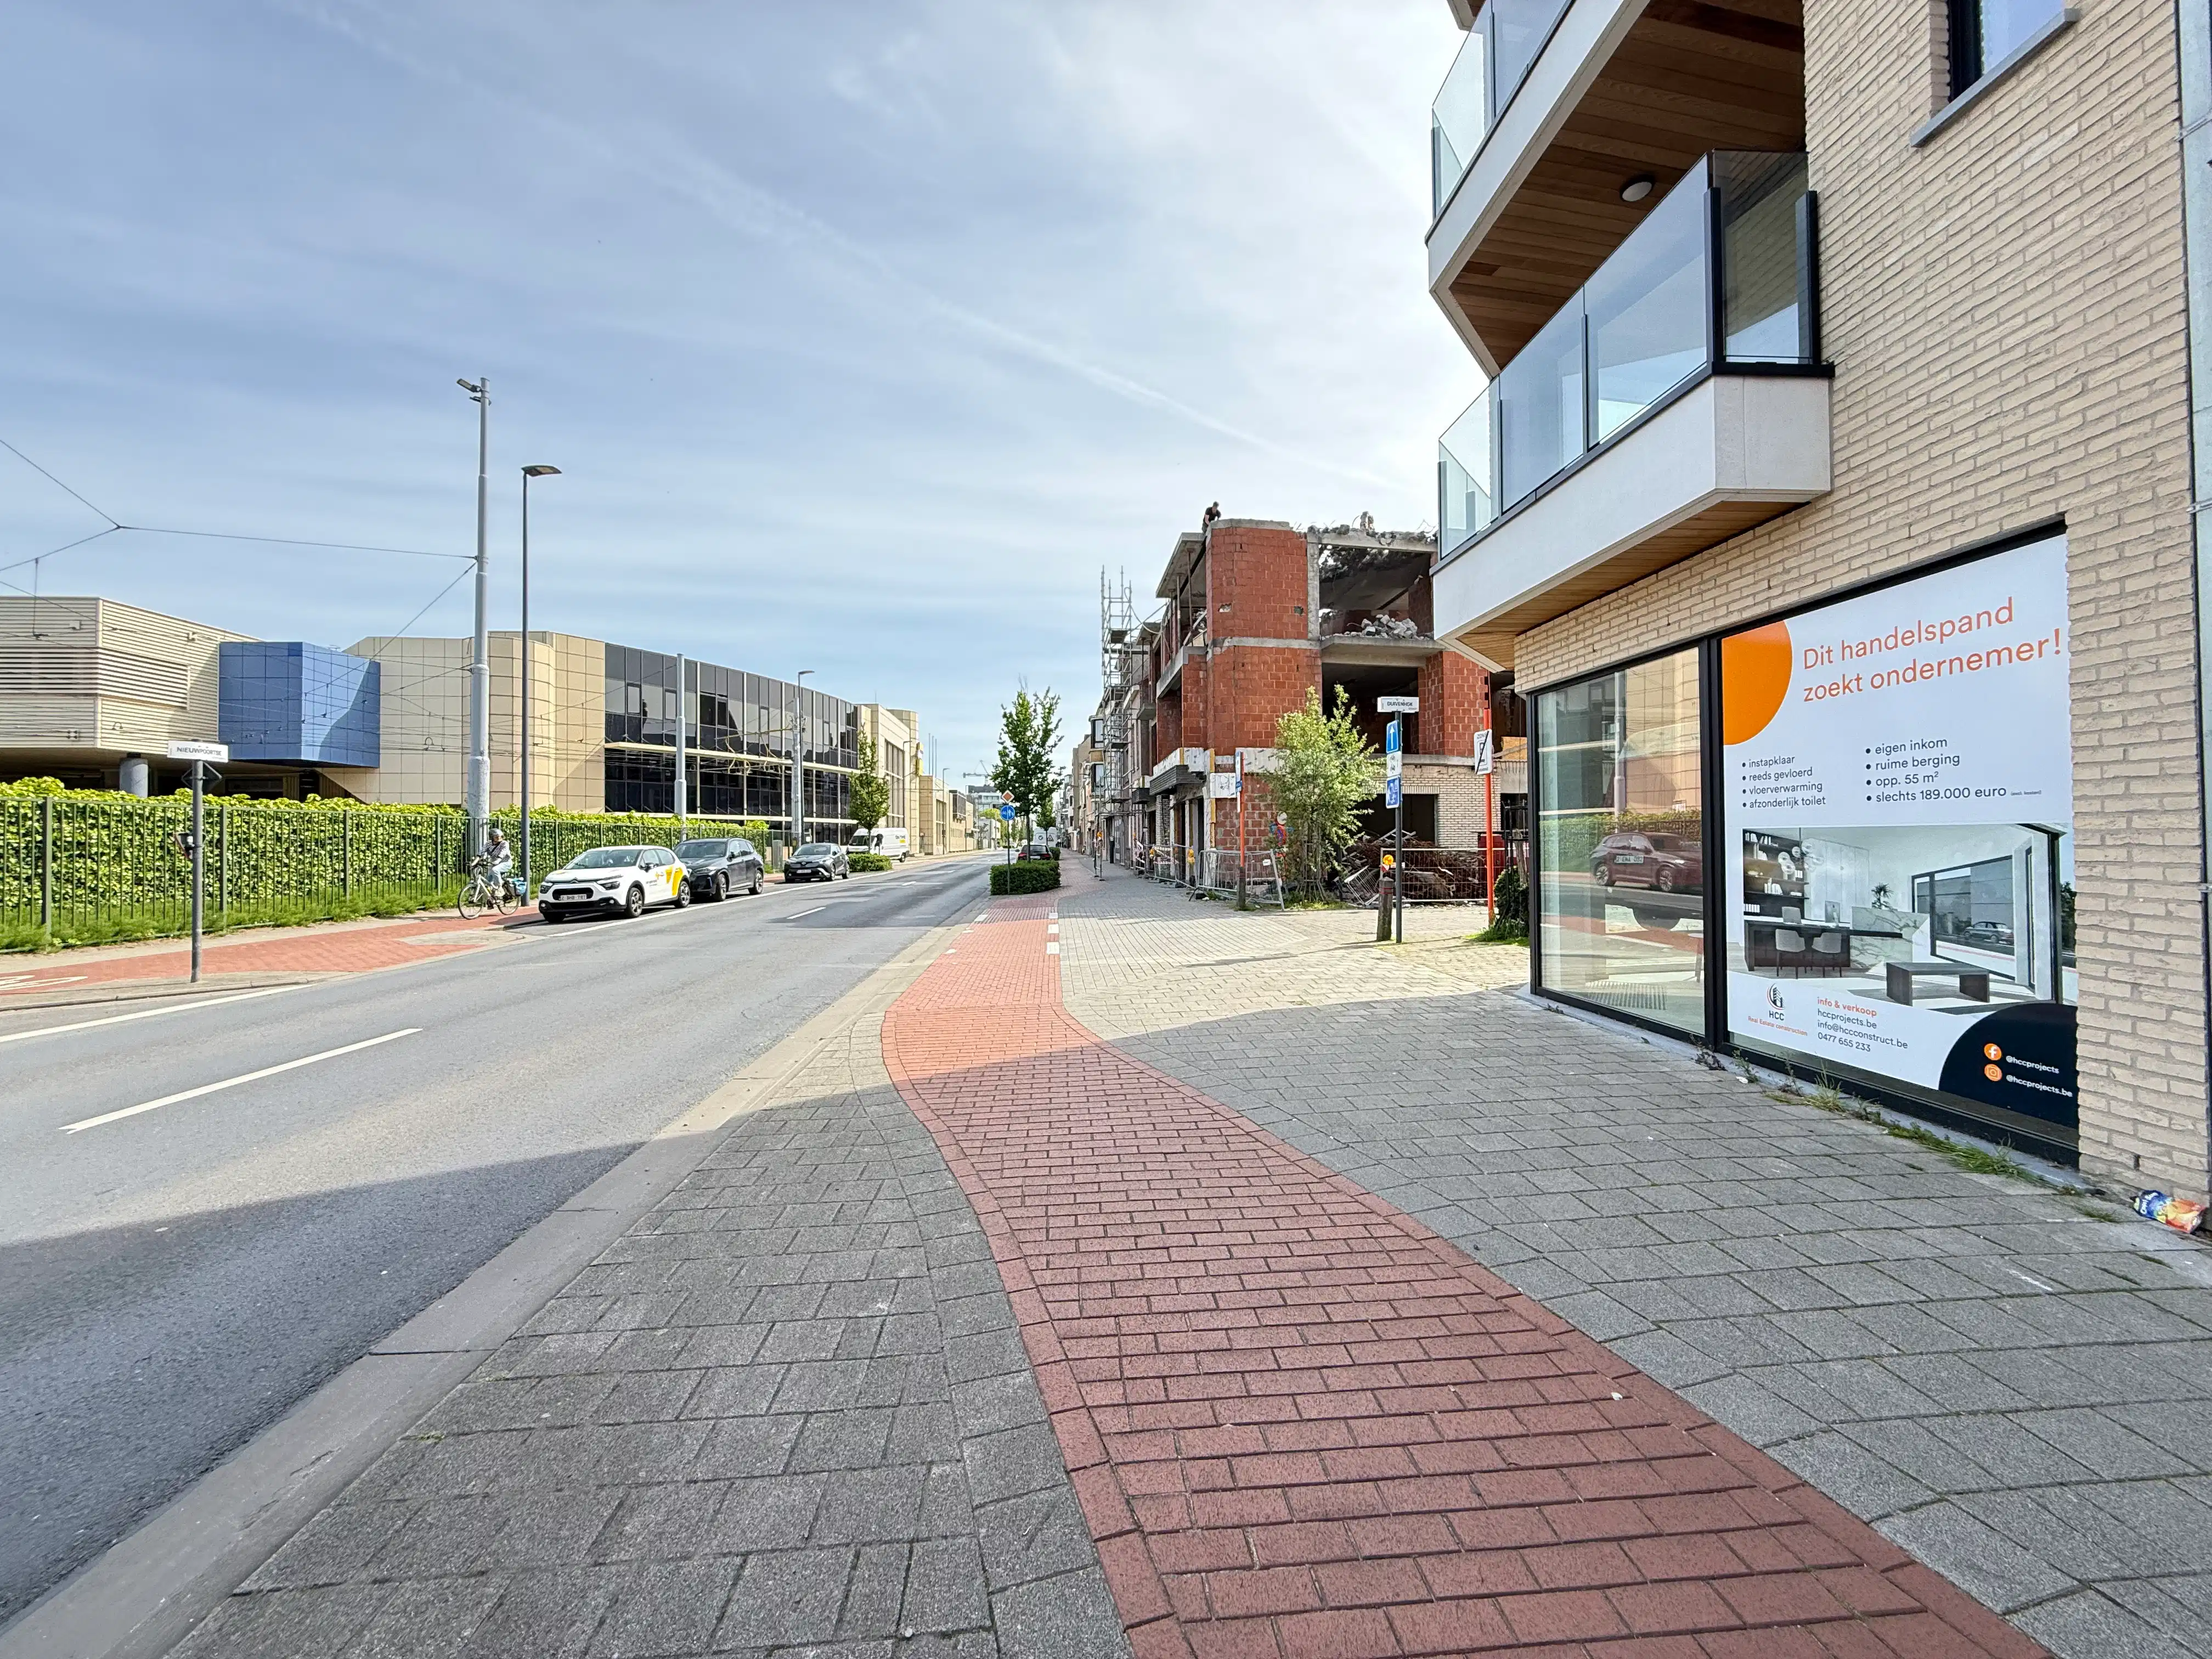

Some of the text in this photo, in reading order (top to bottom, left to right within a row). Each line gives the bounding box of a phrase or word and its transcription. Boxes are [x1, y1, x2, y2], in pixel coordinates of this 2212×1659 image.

[1804, 596, 2013, 669] Dit handelspand
[1804, 628, 2061, 702] zoekt ondernemer!
[177, 747, 222, 756] NIEUWPOORTSE
[1875, 738, 1948, 755] eigen inkom
[1749, 755, 1795, 768] instapklaar
[1876, 754, 1960, 770] ruime berging
[1749, 766, 1813, 781] reeds gevloerd
[1876, 777, 1901, 788] opp.
[1905, 774, 1919, 785] 55
[1749, 781, 1823, 795] vloerverwarming
[1876, 791, 1916, 802] slechts
[1920, 787, 1971, 800] 189.000
[1975, 787, 2007, 798] euro
[1750, 795, 1826, 809] afzonderlijk toilet
[1769, 1010, 1785, 1021] HCC
[1817, 997, 1877, 1018] info & verkoop
[1818, 1008, 1877, 1029] hccprojects.be
[1759, 1019, 1775, 1028] Estate
[1775, 1024, 1808, 1036] construction
[1818, 1019, 1909, 1049] info@hccconstruct.be
[1818, 1032, 1871, 1052] 0477 655 233
[2006, 1055, 2060, 1074] @hccprojects
[2006, 1075, 2073, 1097] @hccprojects.be
